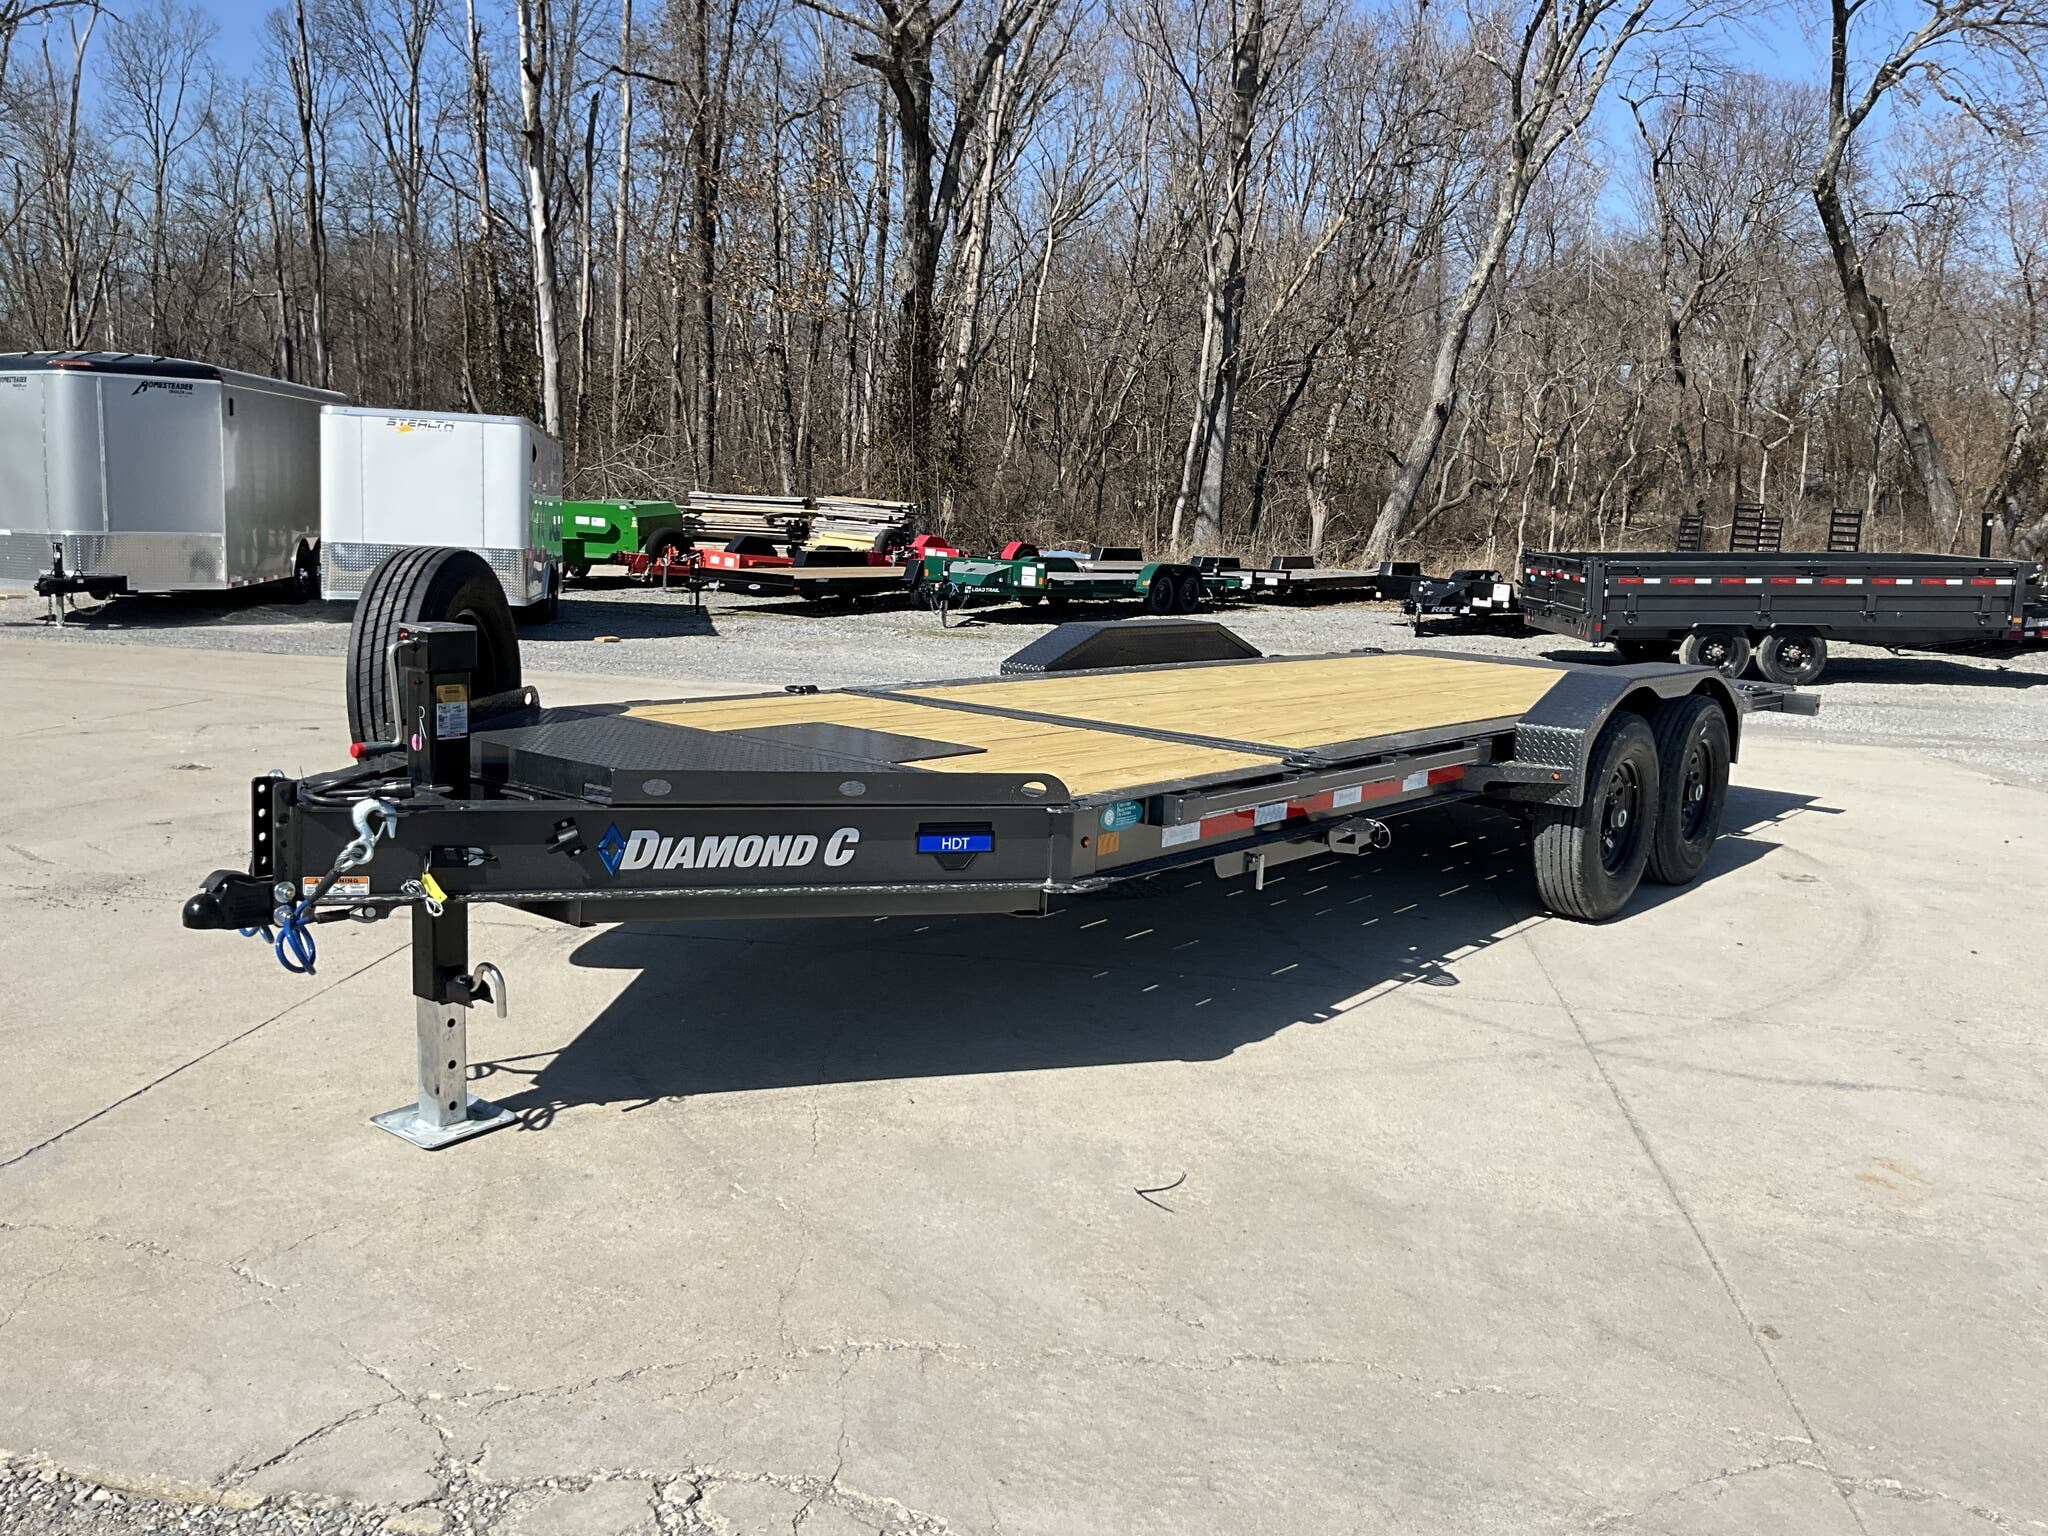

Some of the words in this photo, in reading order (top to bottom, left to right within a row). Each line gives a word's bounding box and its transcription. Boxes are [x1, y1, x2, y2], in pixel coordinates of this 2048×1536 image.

[131, 380, 193, 396] HOMESTEADER
[386, 418, 455, 430] STEALTH
[619, 829, 819, 870] DIAMOND
[823, 826, 860, 867] C
[941, 837, 970, 850] HDT
